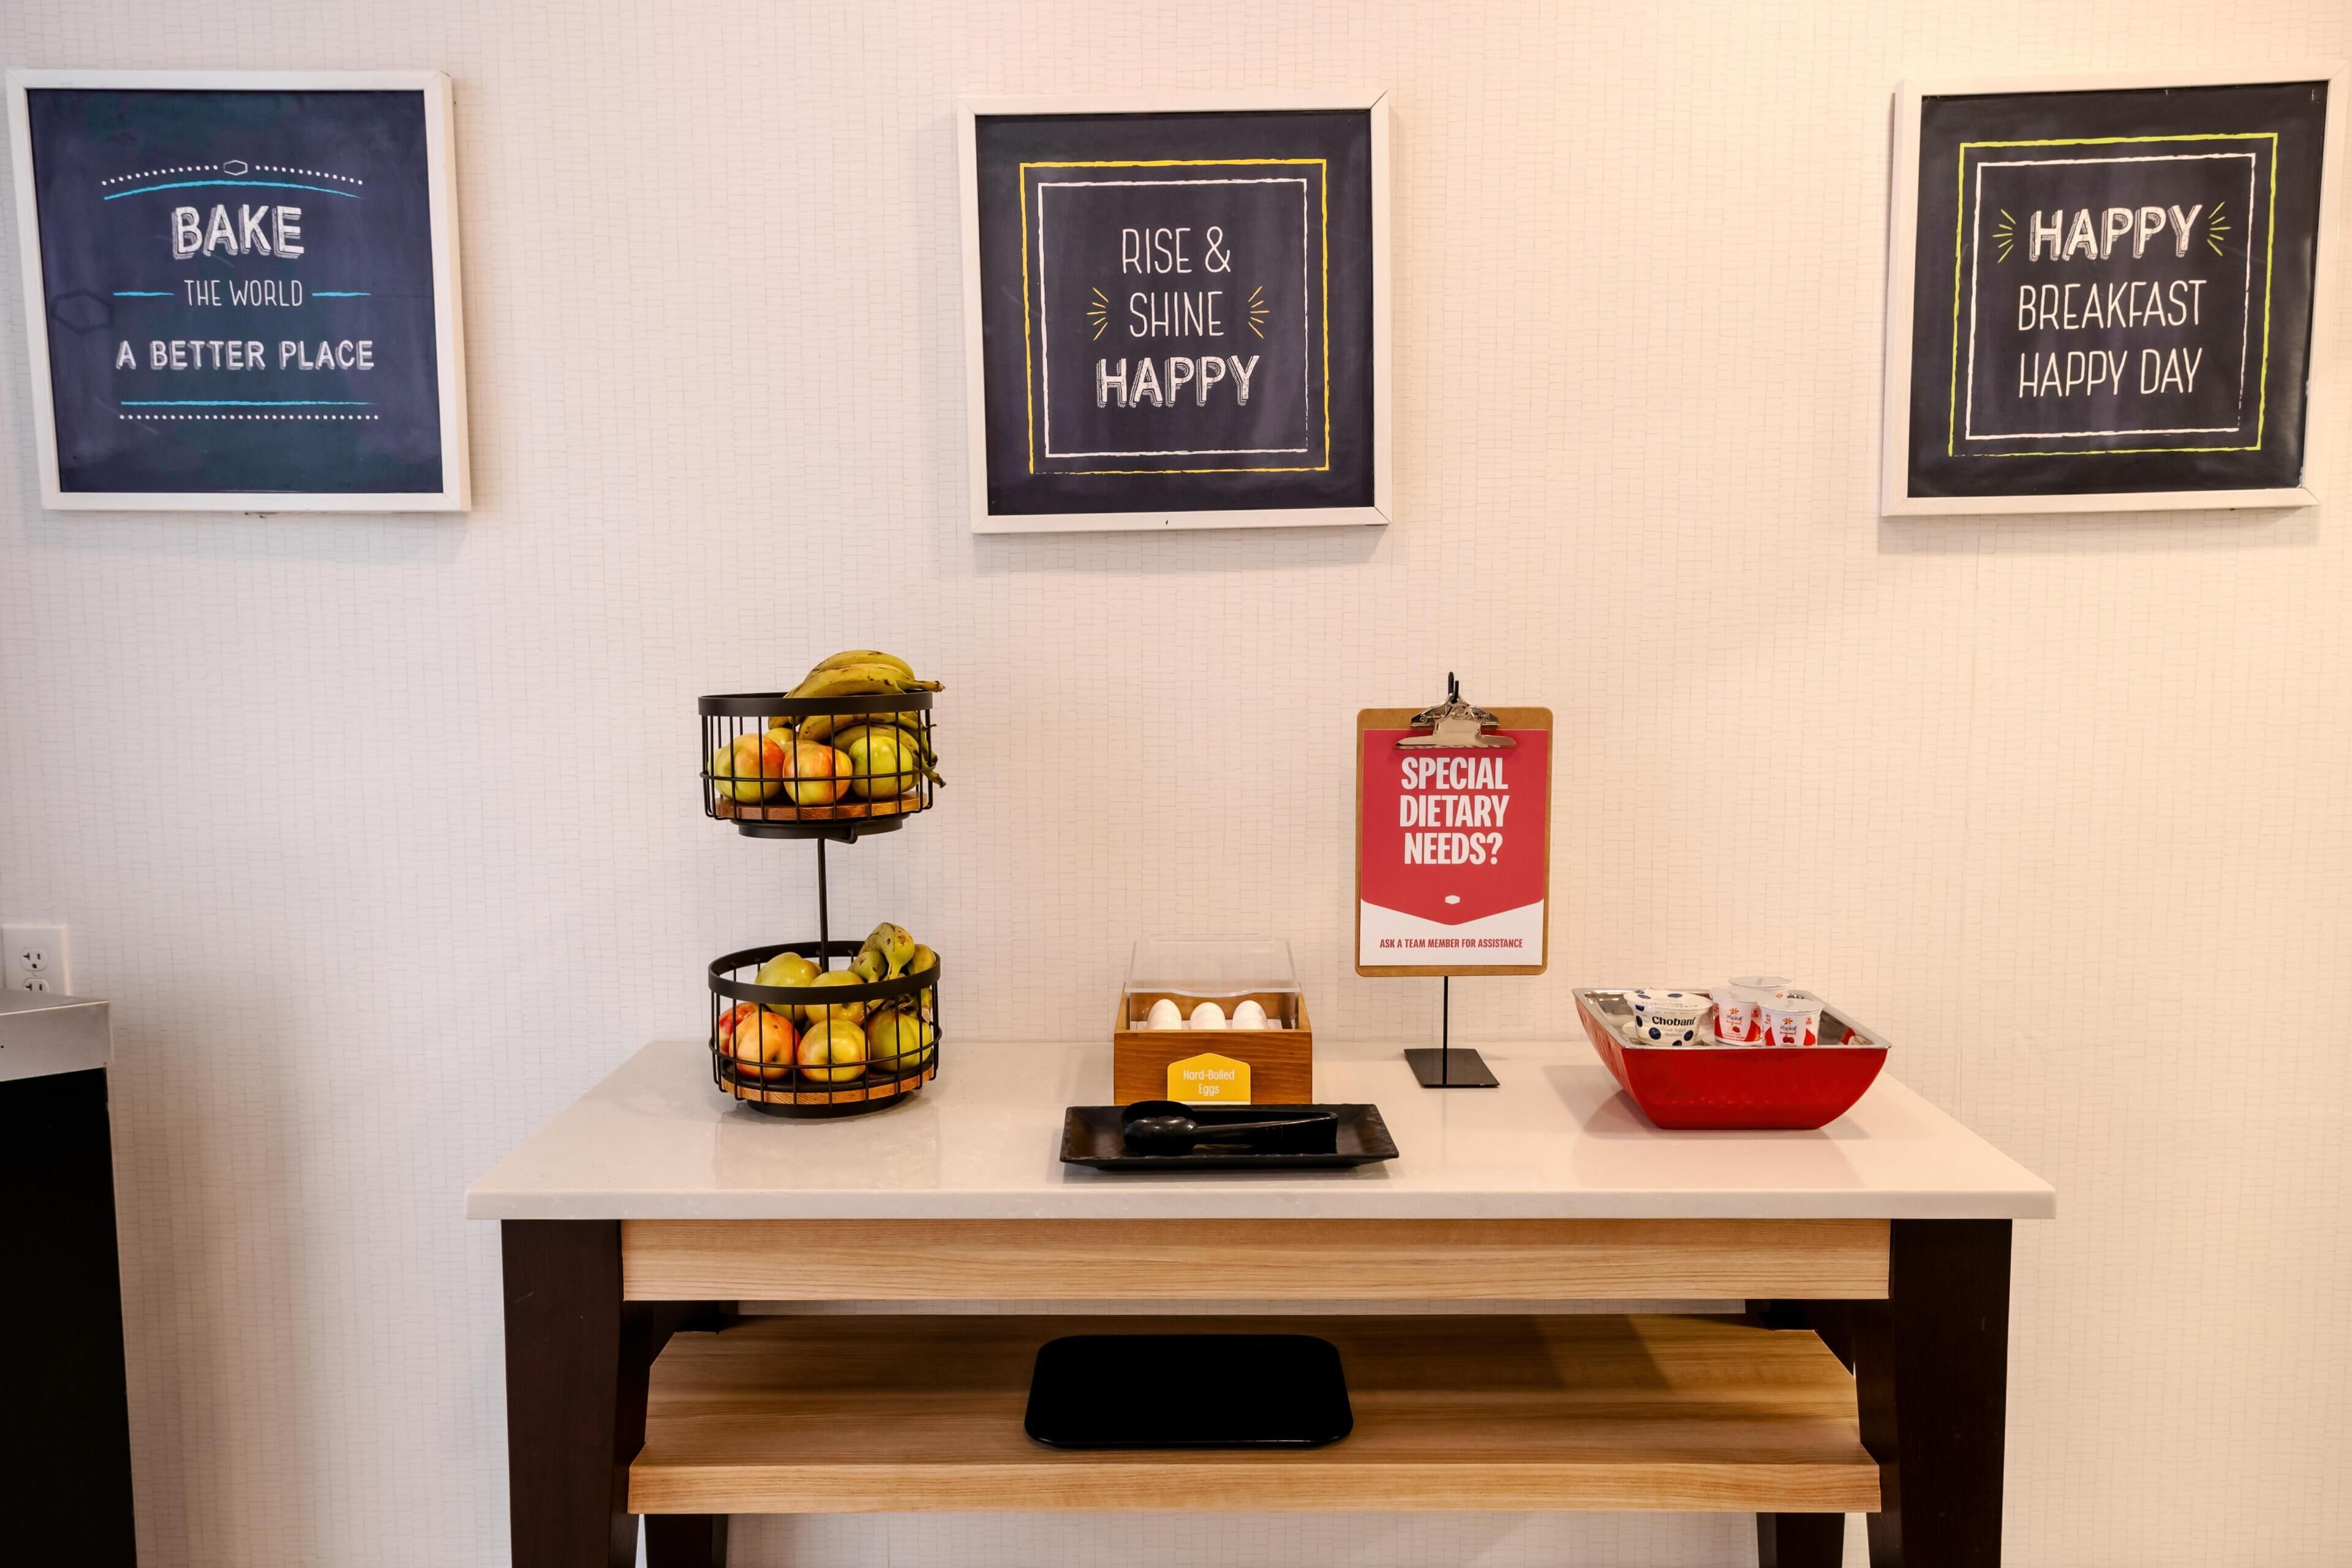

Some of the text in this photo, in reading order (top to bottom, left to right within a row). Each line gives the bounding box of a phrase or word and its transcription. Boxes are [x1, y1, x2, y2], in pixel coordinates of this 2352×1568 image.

[171, 204, 304, 260] BAKE
[2029, 204, 2203, 262] HAPPY
[1122, 225, 1231, 274] RISE &
[184, 280, 303, 306] THE WORLD
[2018, 280, 2207, 331] BREAKFAST
[1129, 291, 1224, 337] SHINE
[116, 340, 374, 370] A BETTER PLACE
[1096, 355, 1260, 408] HAPPY
[2019, 347, 2203, 398] HAPPY DAY
[1401, 756, 1509, 790] SPECIAL
[1400, 795, 1510, 827] DIETARY
[1404, 832, 1503, 865] NEEDS?
[1379, 938, 1523, 948] ASK A TEAM MEMBER FOR ASSISTANCE
[1183, 1069, 1235, 1080] Hard-Boiled
[1198, 1084, 1219, 1096] Eggs
